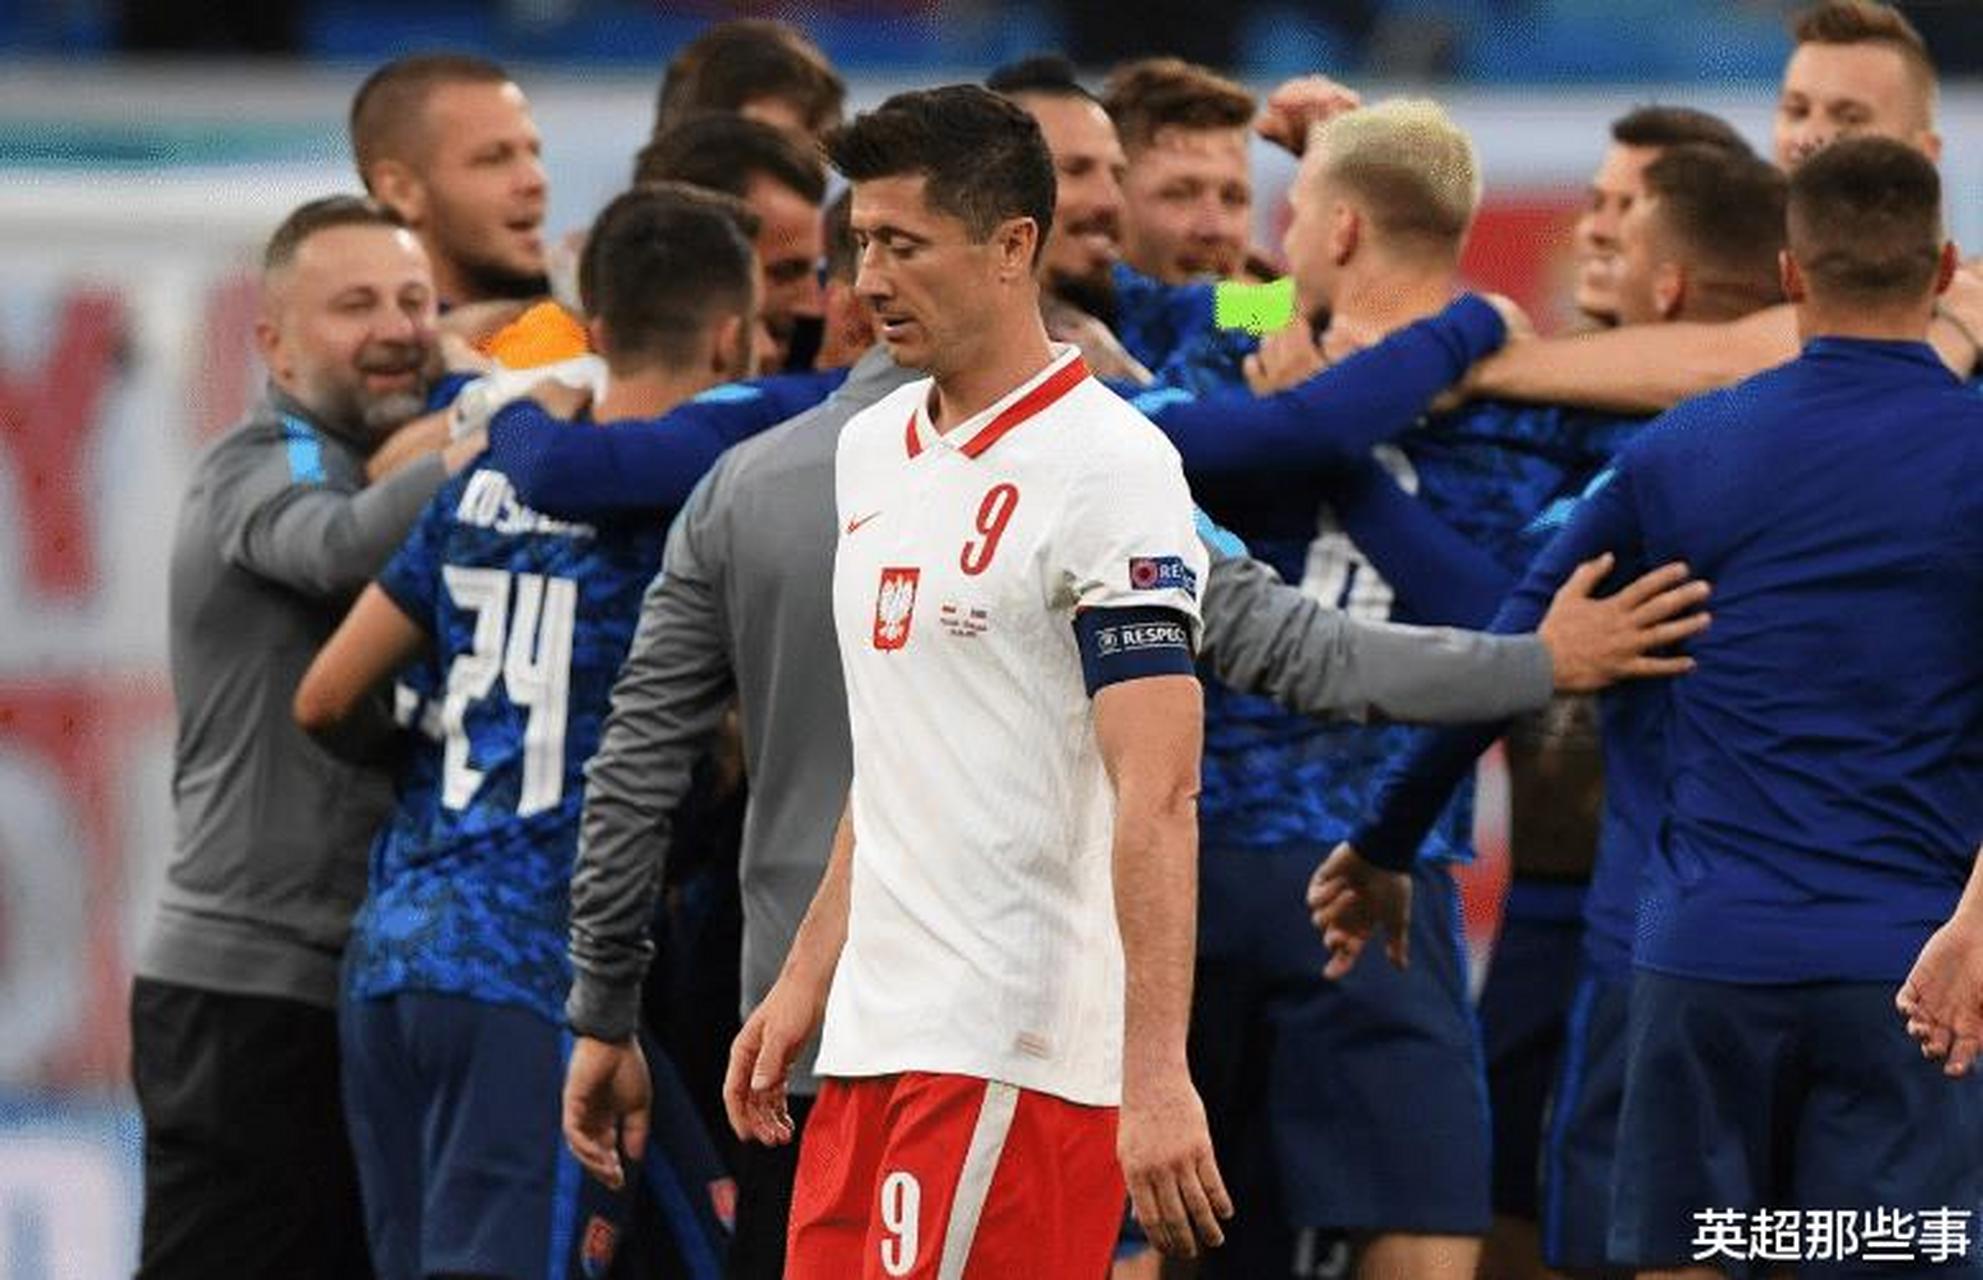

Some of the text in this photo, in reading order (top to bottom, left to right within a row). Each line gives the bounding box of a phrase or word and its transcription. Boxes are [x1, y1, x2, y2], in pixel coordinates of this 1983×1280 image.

[960, 483, 1019, 576] 9
[1123, 627, 1187, 645] RESPEC
[442, 564, 578, 819] 24
[881, 1171, 920, 1277] 9
